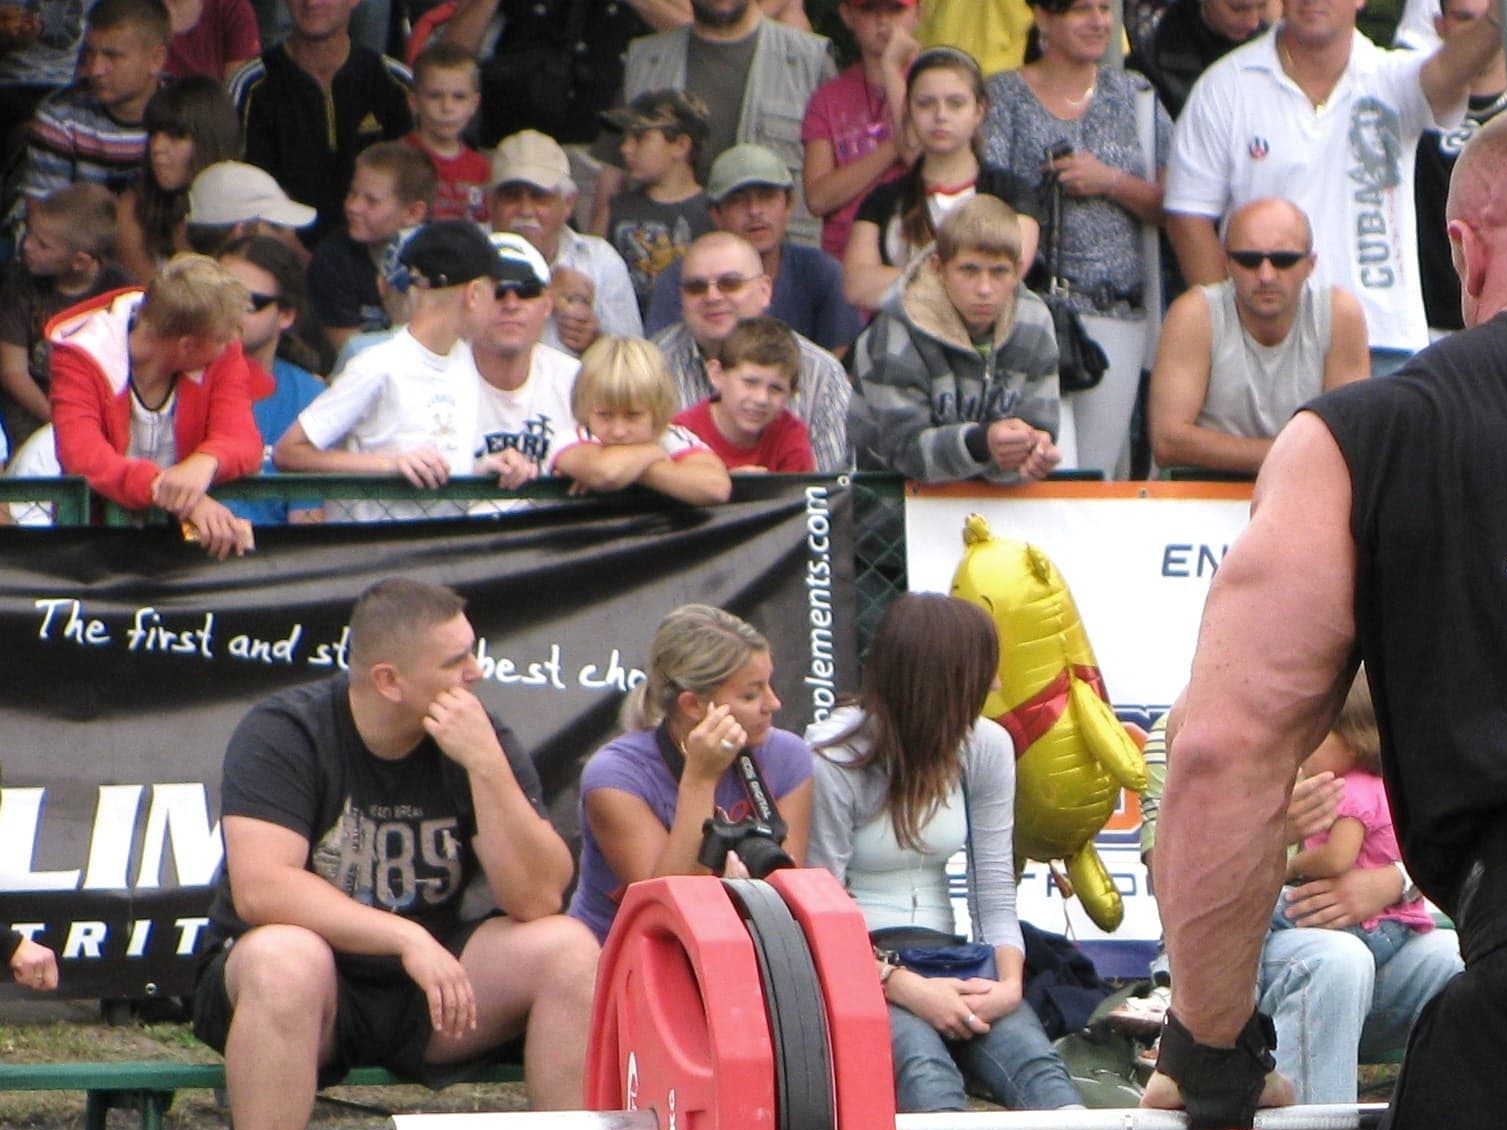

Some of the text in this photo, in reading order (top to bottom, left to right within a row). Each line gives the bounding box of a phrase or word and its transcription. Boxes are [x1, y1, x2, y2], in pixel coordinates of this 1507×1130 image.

[1354, 184, 1395, 288] CUBA
[35, 598, 111, 644] The
[127, 606, 214, 658] first
[227, 623, 302, 663] and
[476, 637, 567, 689] best
